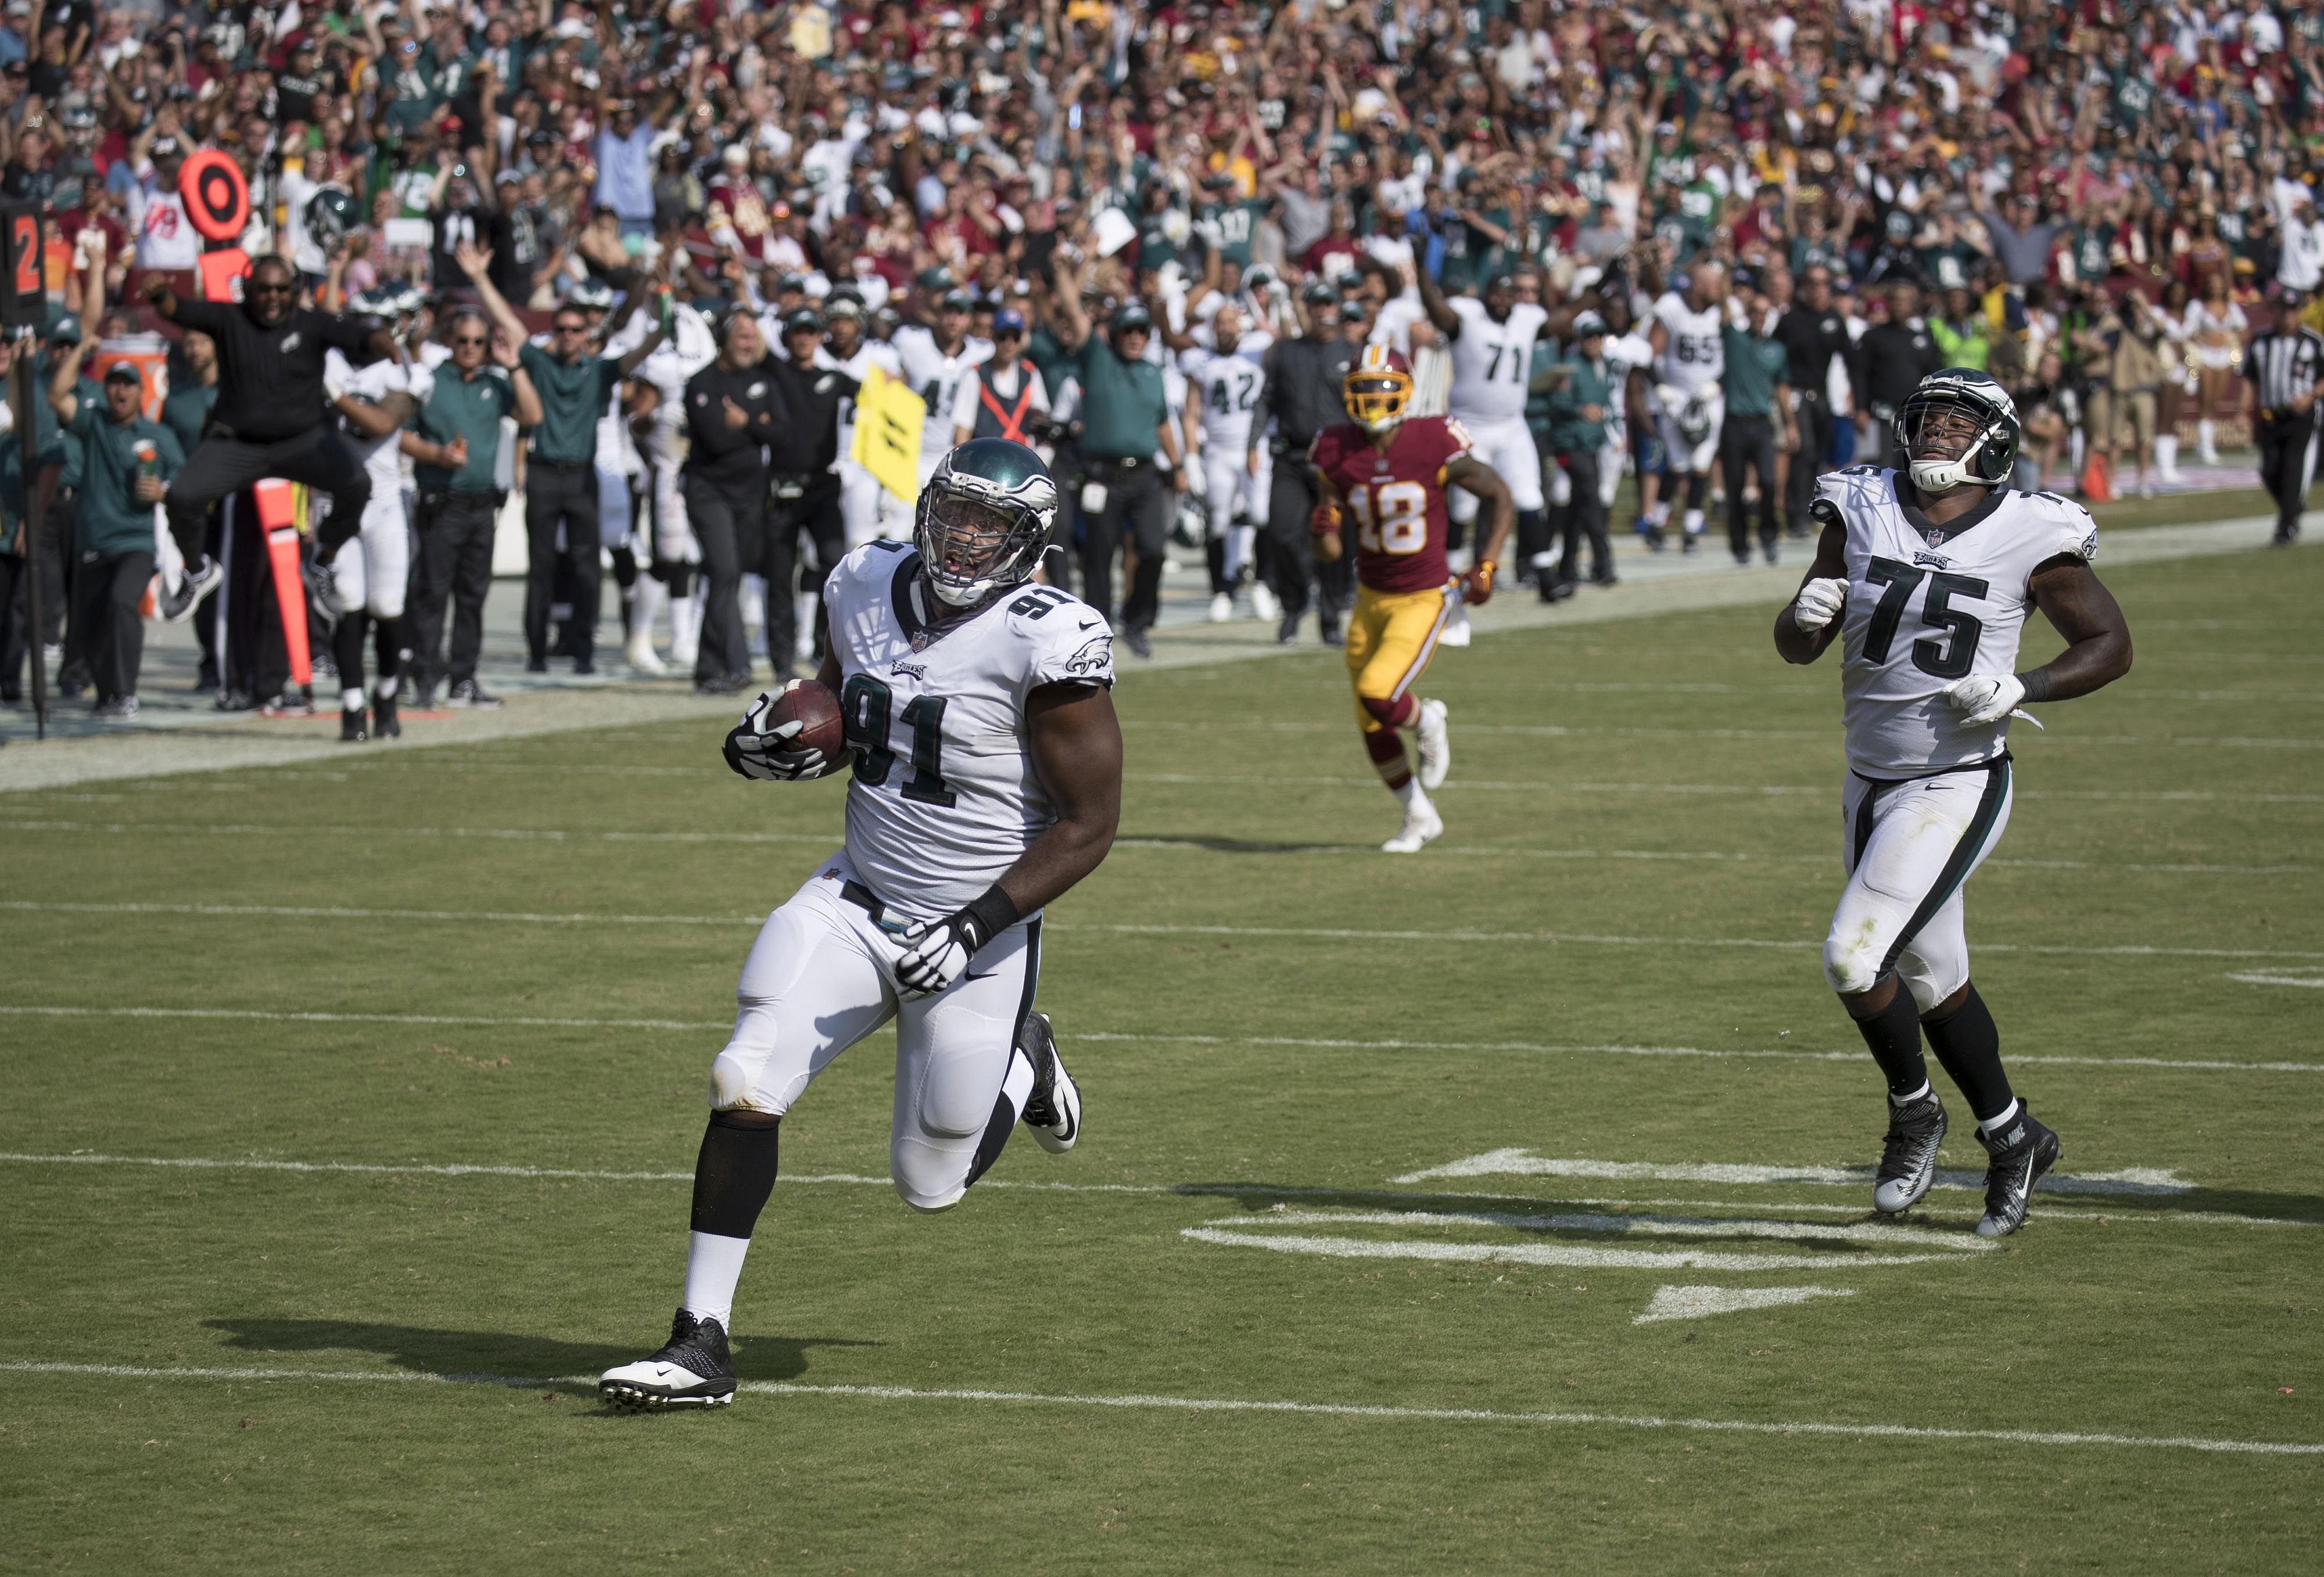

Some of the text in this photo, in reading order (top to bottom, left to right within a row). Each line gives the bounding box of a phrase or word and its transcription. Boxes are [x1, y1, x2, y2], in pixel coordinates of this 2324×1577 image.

[15, 214, 40, 296] 2
[1486, 343, 1521, 383] 71
[1211, 374, 1254, 415] 42
[1347, 480, 1428, 555] 18
[1913, 551, 1951, 571] EAGLES
[1008, 588, 1077, 621] 91
[1862, 555, 1990, 680] 75
[891, 659, 927, 681] EAGLES
[842, 672, 957, 809] 91
[2007, 1121, 2025, 1147] NIKE
